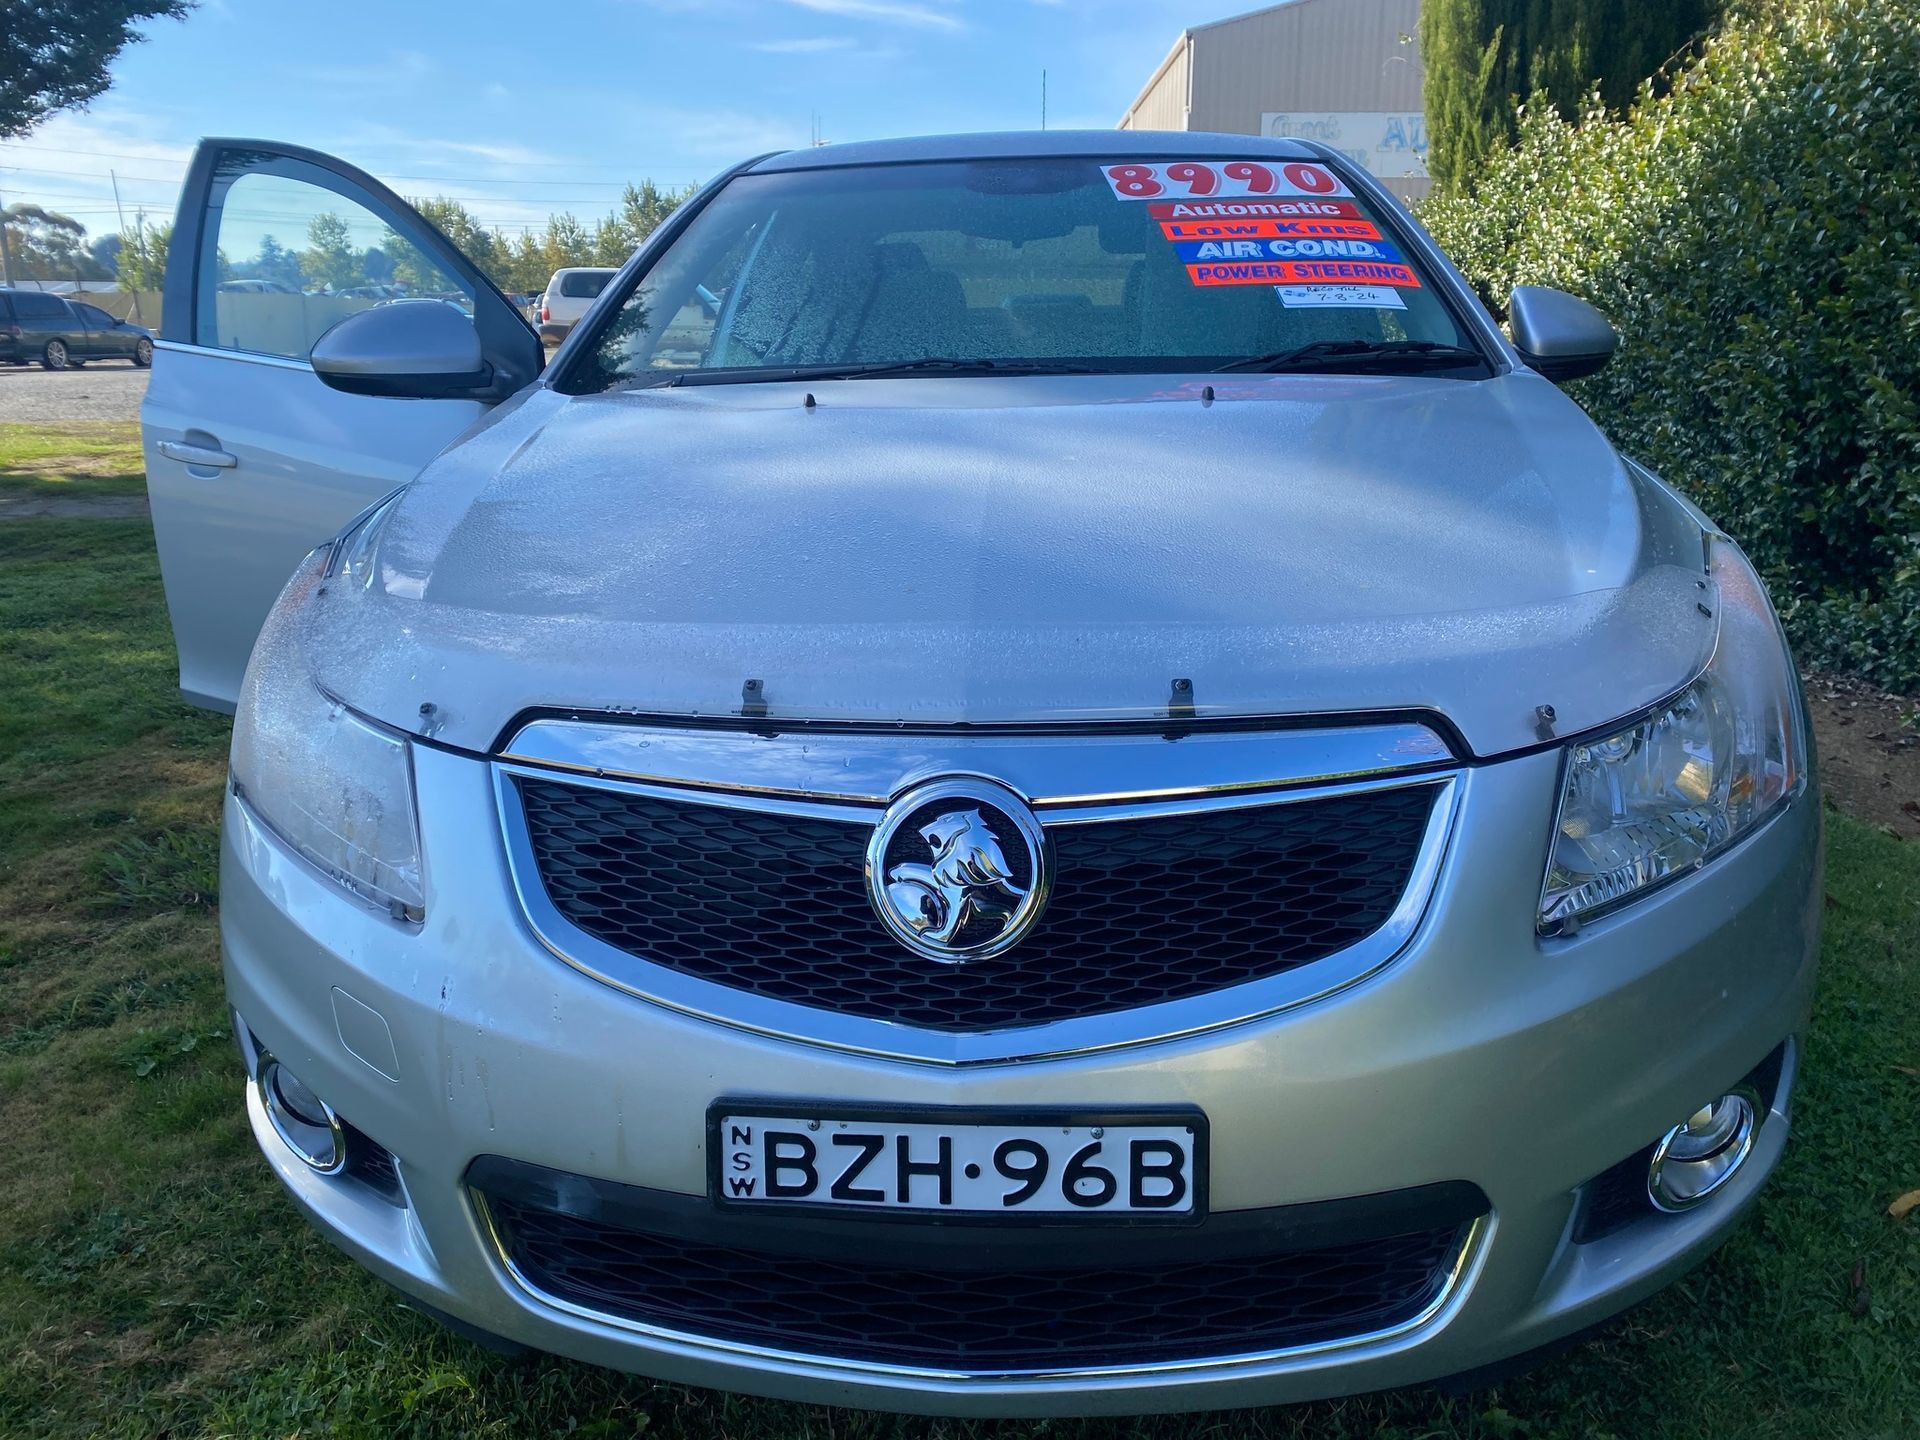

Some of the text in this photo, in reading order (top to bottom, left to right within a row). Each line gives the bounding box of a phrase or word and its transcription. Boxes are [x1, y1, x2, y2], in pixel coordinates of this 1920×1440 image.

[1107, 161, 1342, 198] 8990
[1172, 202, 1341, 217] Automatic
[1196, 239, 1386, 260] AIR COND.
[1197, 263, 1412, 282] POWER STEERING
